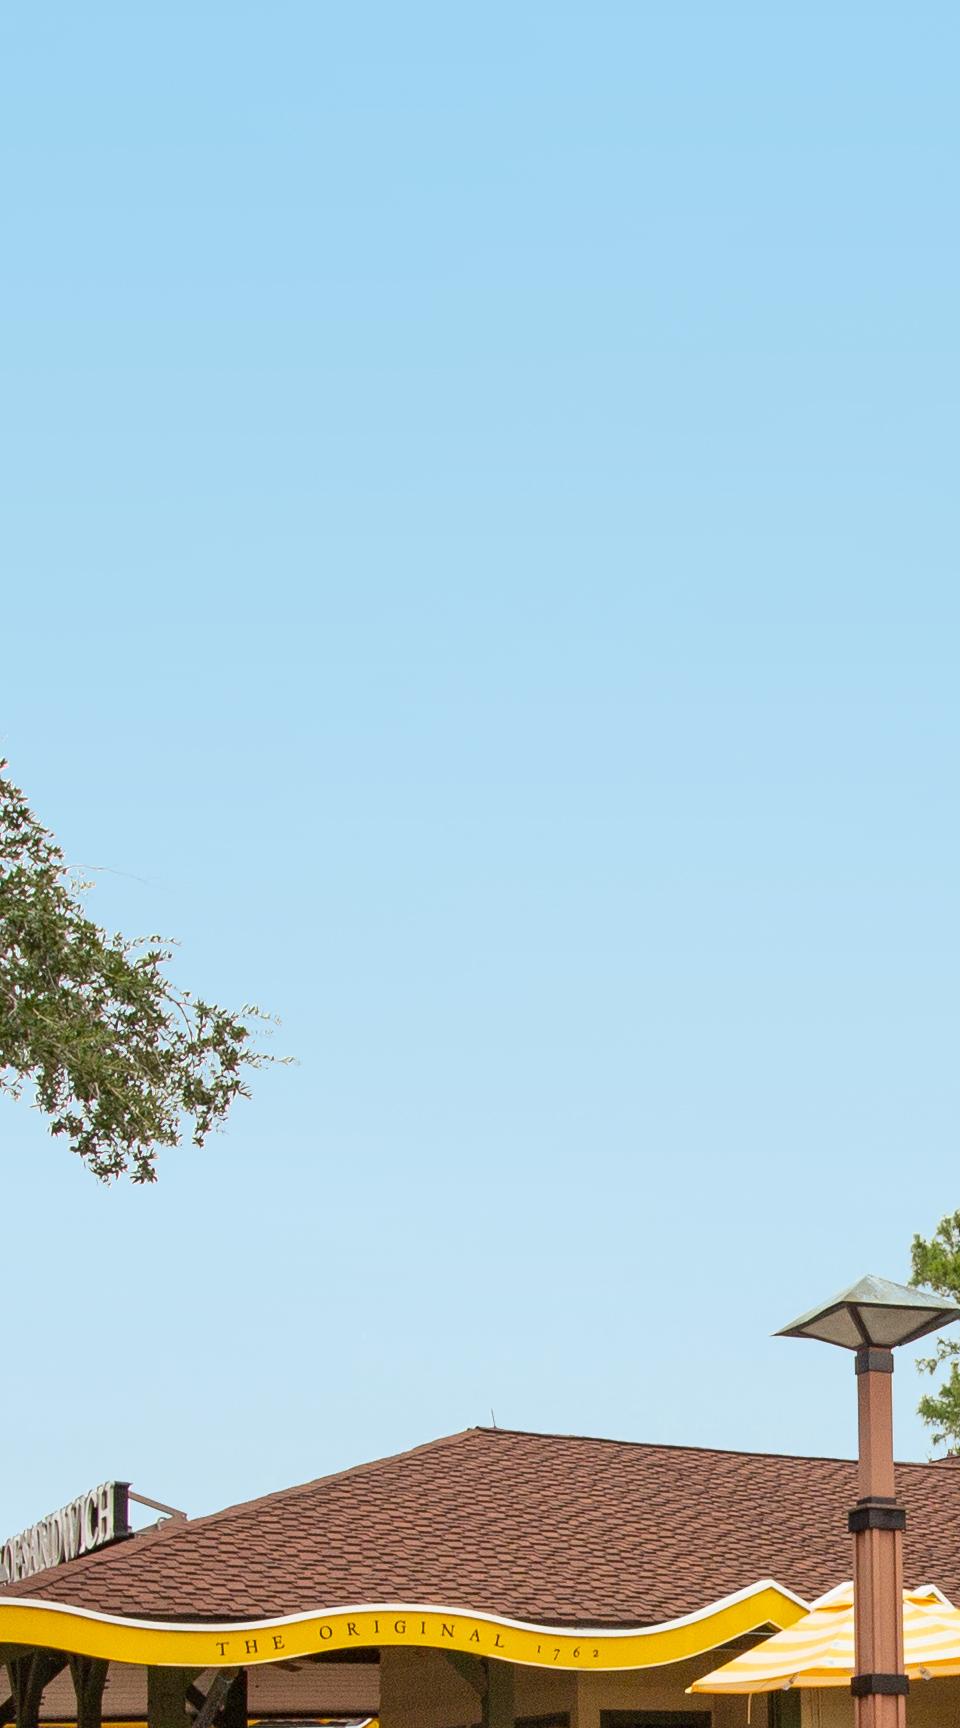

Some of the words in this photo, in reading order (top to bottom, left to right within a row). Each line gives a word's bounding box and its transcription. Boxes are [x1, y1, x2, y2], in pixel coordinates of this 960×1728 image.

[21, 1481, 115, 1578] SANDWICH
[216, 1635, 285, 1656] THE
[318, 1619, 505, 1648] ORIGINAL
[537, 1645, 600, 1661] 1762
